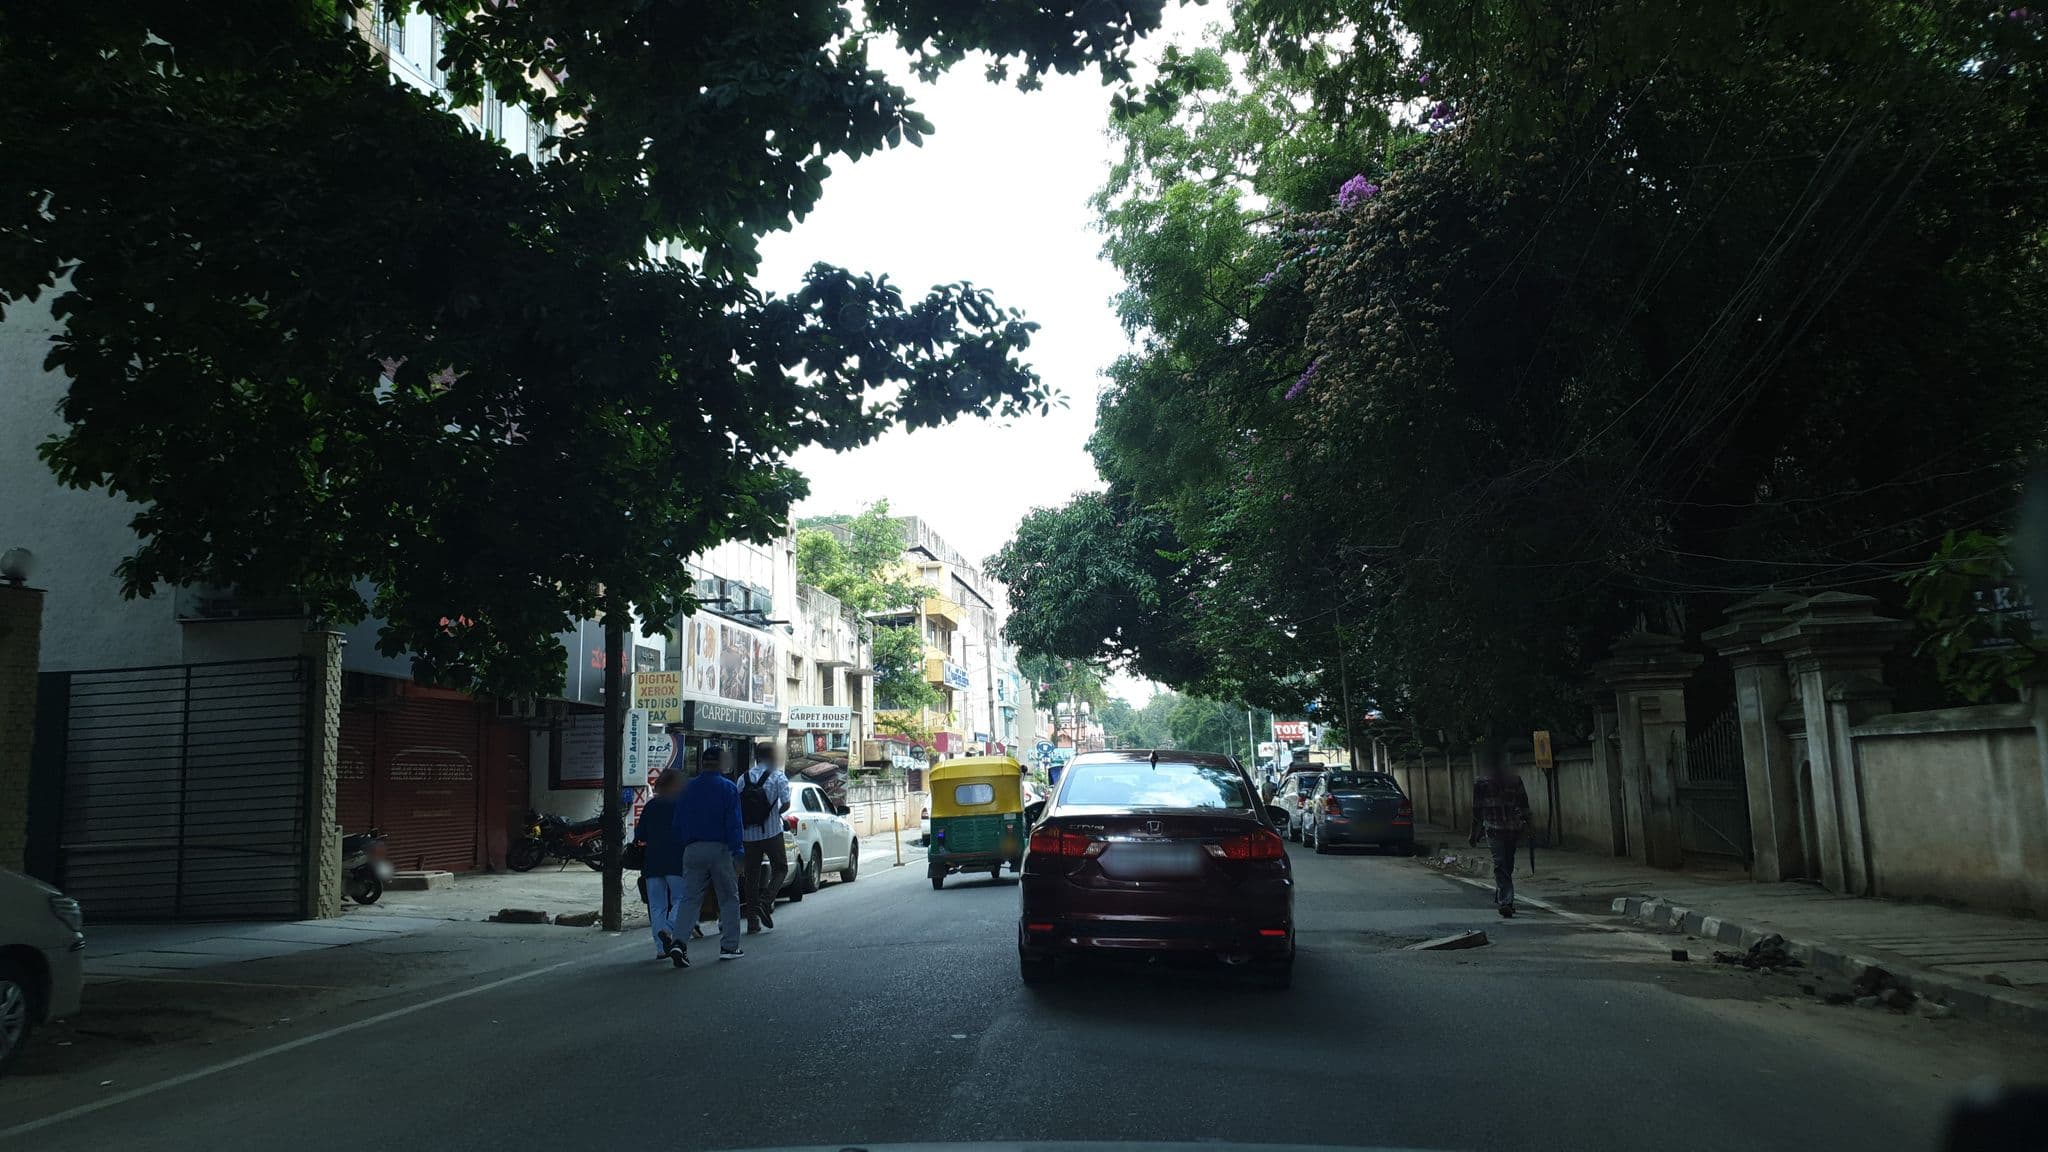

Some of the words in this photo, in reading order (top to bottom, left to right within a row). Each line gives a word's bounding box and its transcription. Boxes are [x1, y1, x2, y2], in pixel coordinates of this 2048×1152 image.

[638, 674, 678, 684] DIGITAL
[641, 686, 675, 697] XEROX
[637, 698, 678, 708] STD/ISD
[648, 710, 667, 721] FAX
[701, 704, 736, 722] CARPET
[738, 710, 767, 725] HOUSE
[790, 712, 820, 721] CARPET
[822, 713, 849, 721] HOUSE
[629, 713, 640, 752] Academy
